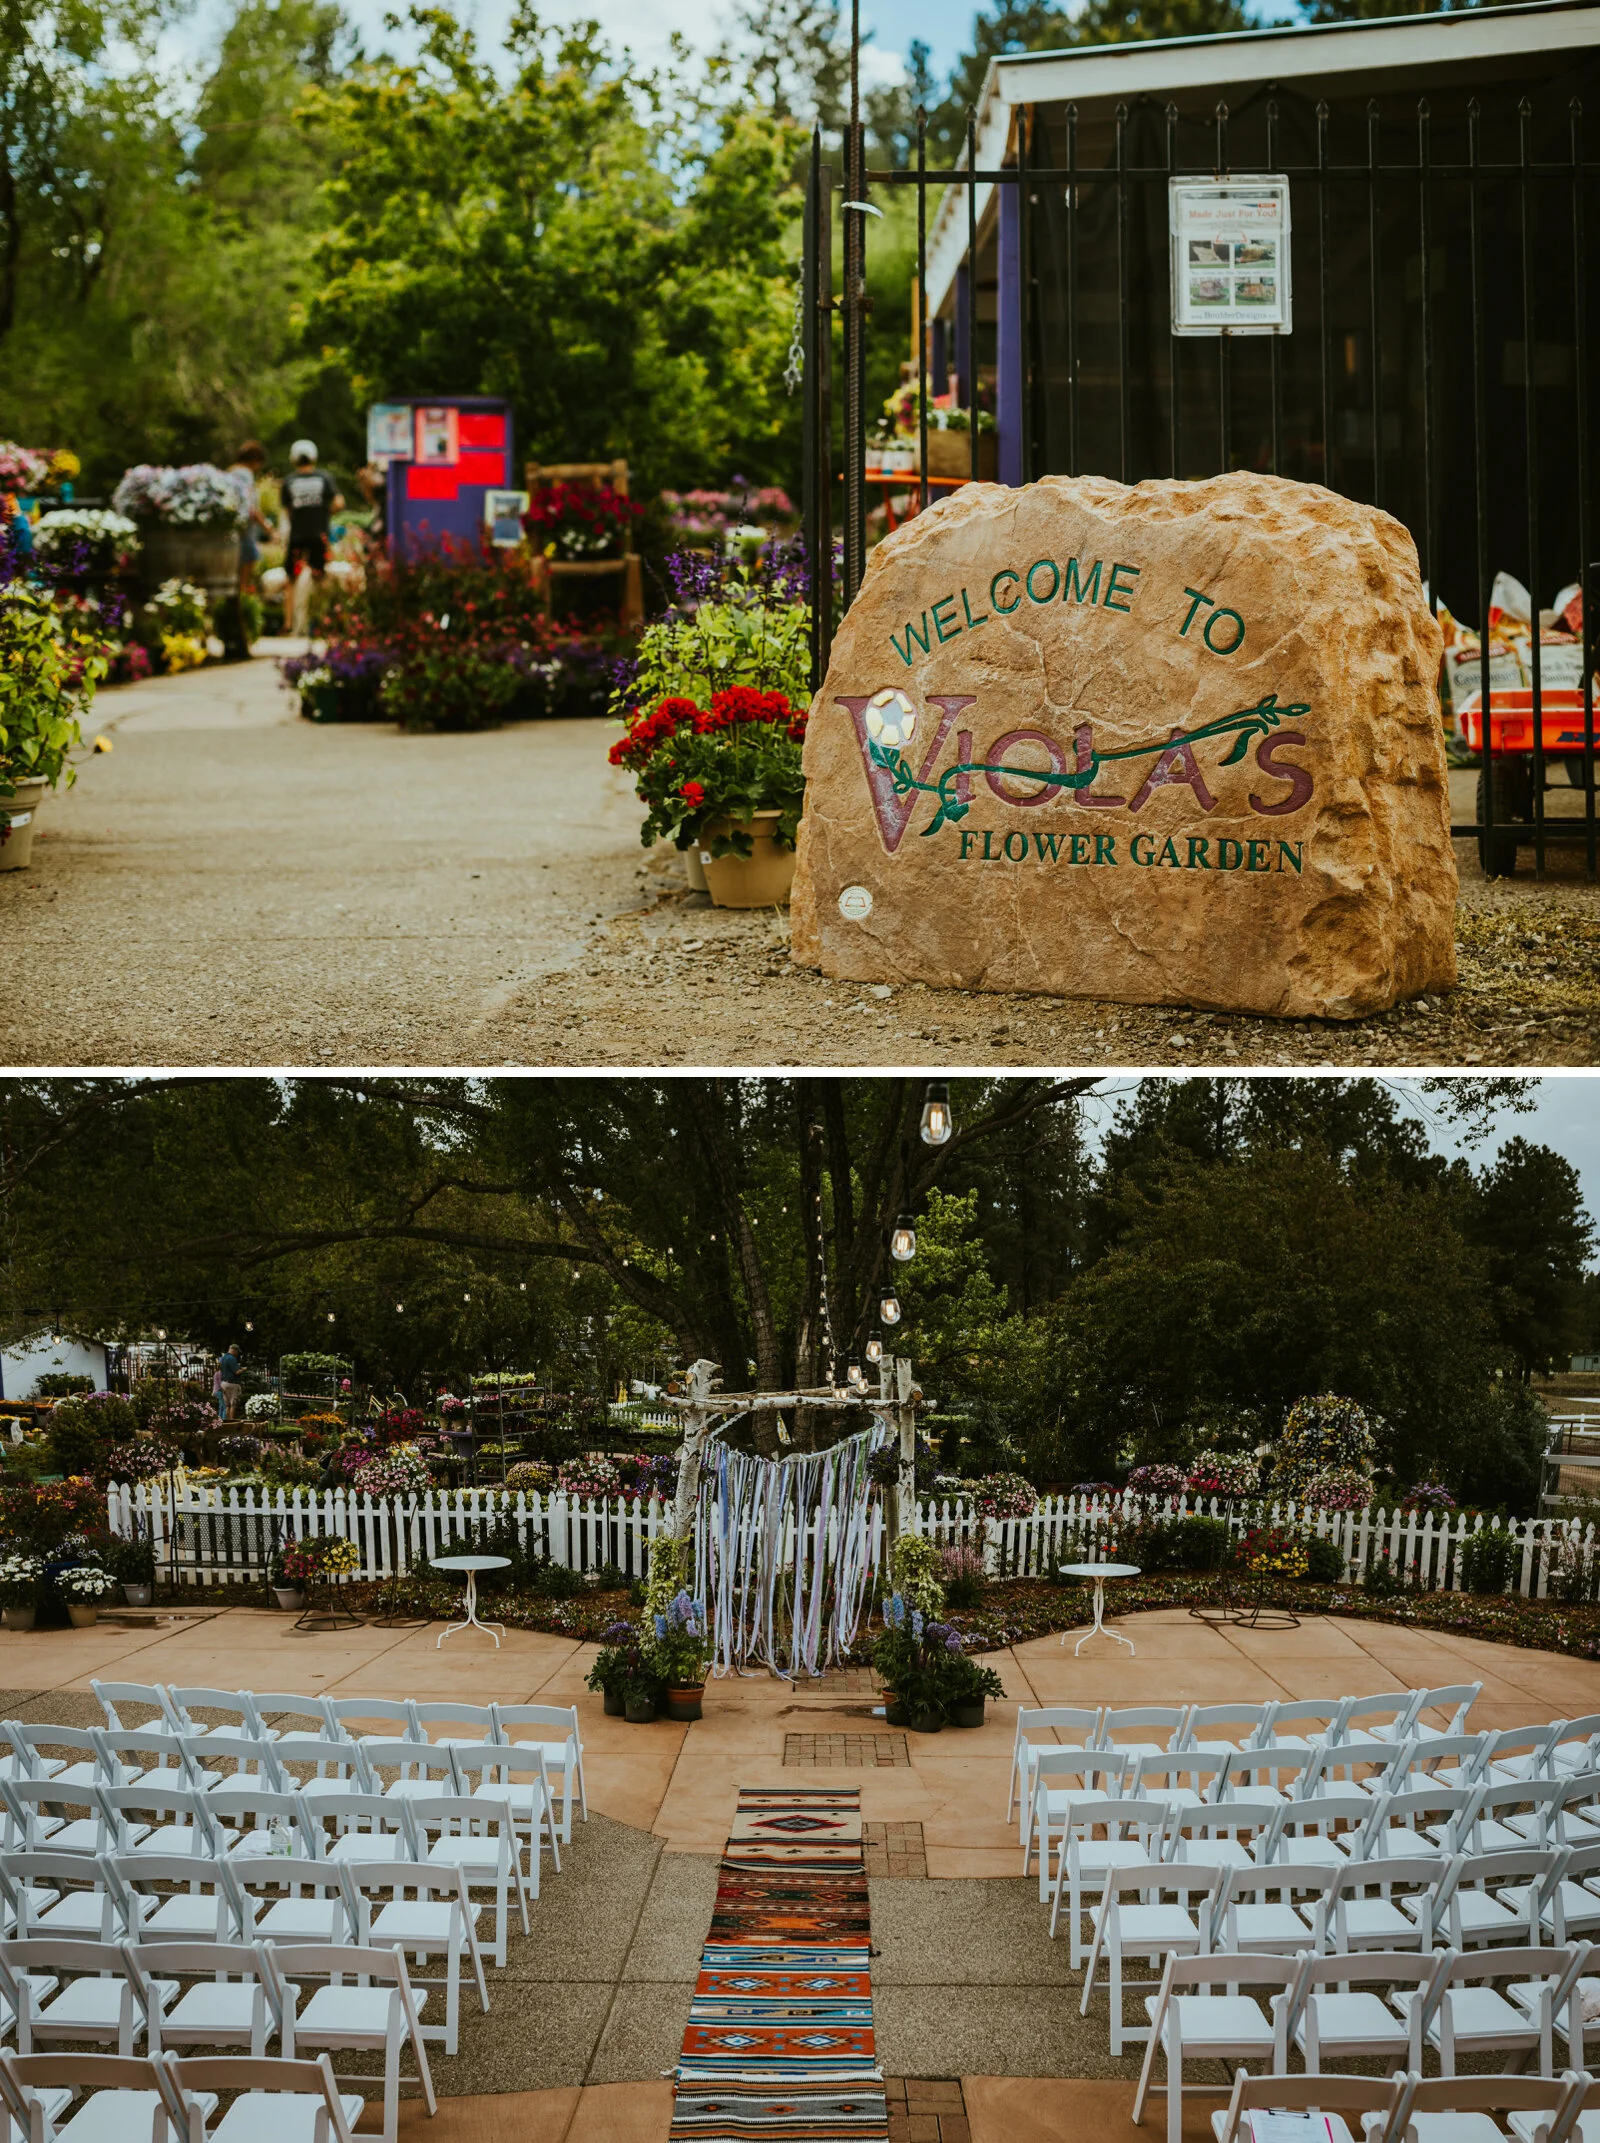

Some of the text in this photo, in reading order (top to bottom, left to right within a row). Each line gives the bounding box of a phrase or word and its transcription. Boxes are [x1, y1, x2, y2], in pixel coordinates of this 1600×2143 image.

[1189, 210, 1212, 218] Made
[889, 556, 1246, 667] WELCOME TO
[959, 829, 1305, 875] FLOWER GARDEN
